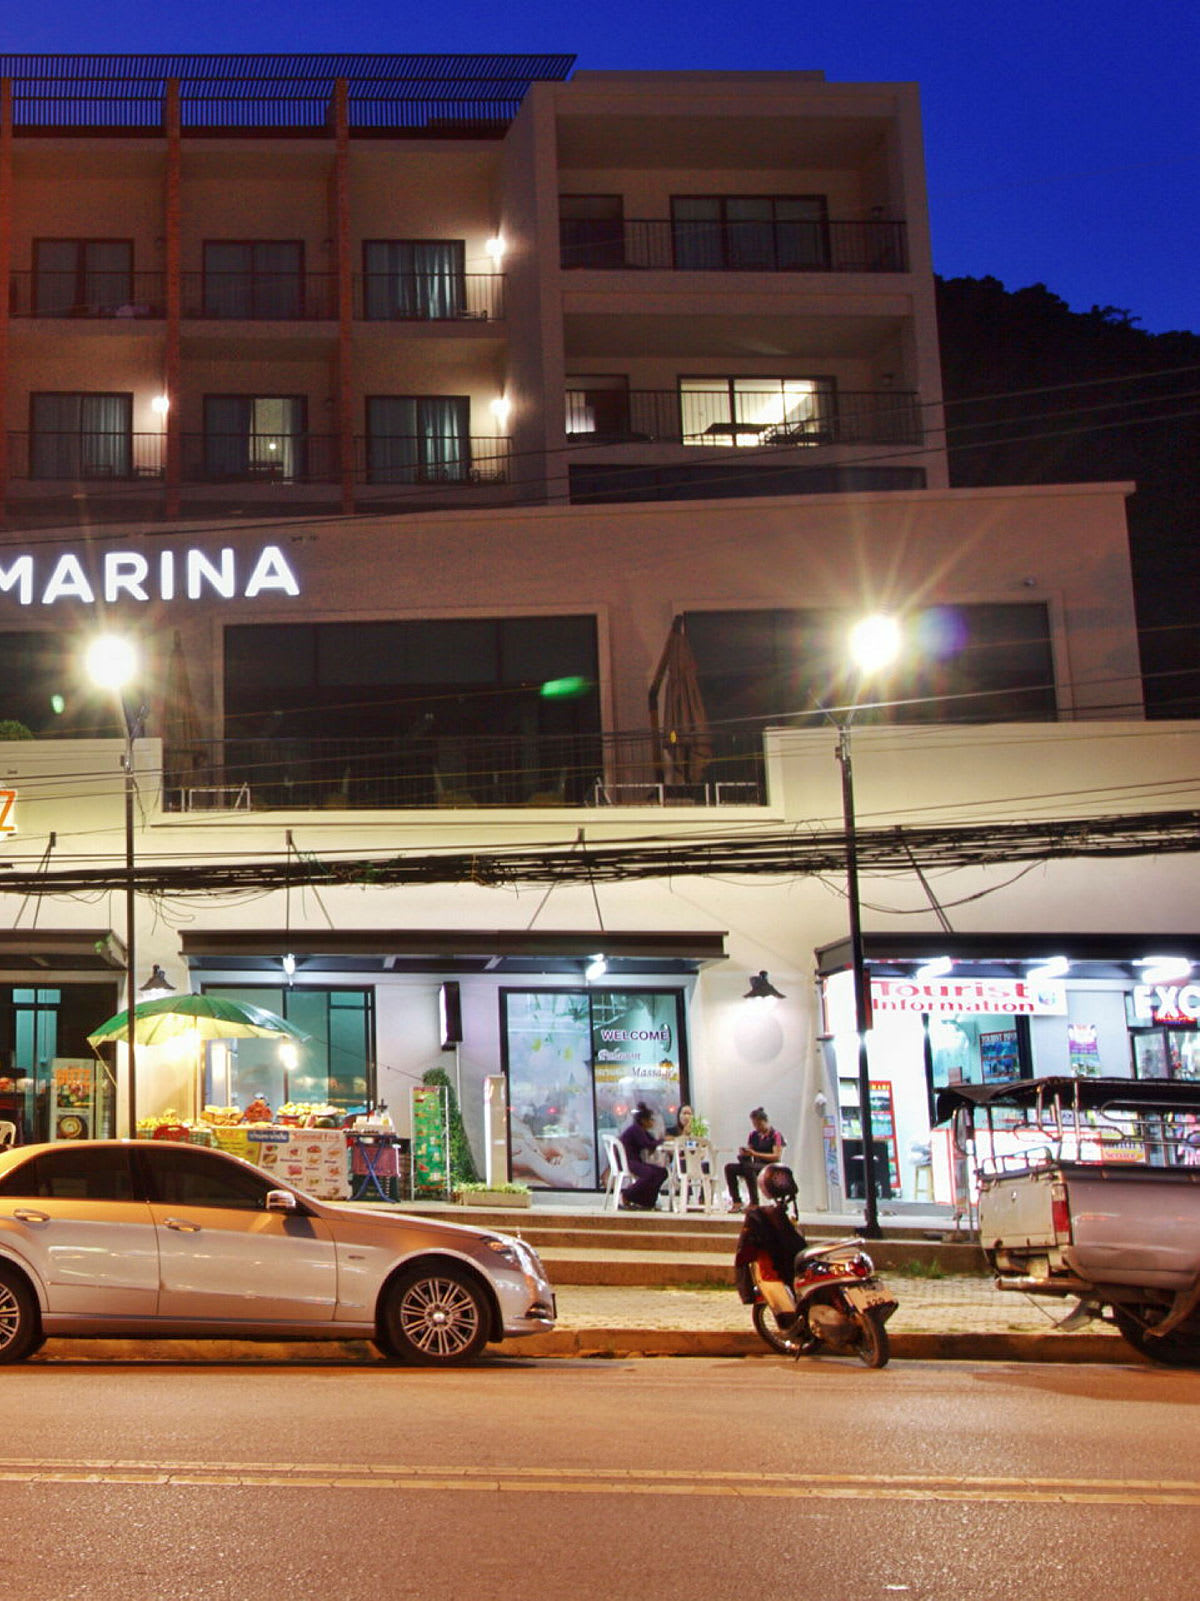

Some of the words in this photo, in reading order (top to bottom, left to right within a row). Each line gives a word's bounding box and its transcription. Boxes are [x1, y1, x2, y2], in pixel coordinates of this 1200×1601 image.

[871, 981, 1030, 999] Tourist
[872, 998, 1035, 1013] Information
[601, 1030, 668, 1042] WELCOME
